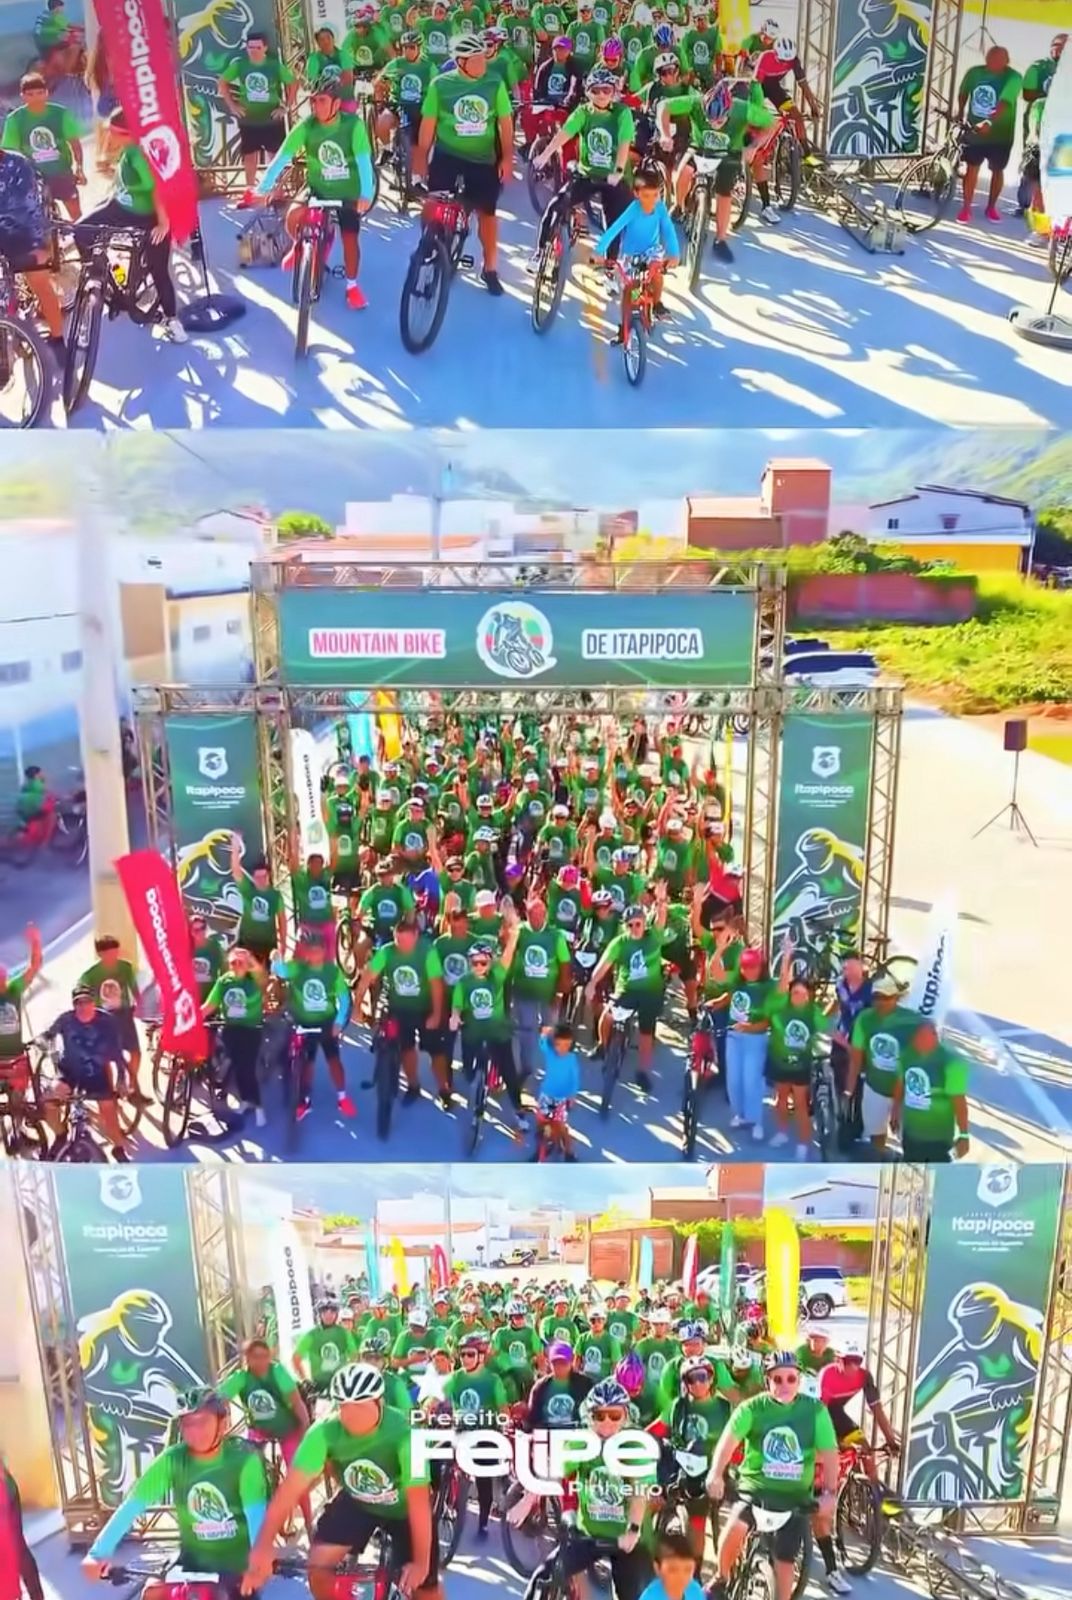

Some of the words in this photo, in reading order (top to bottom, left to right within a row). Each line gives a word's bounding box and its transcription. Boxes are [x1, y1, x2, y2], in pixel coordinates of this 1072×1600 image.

[313, 632, 399, 655] MOUNTAIN
[403, 632, 442, 655] BIKE
[586, 632, 607, 655] DE
[612, 632, 700, 655] ITAPIPOCA
[82, 1223, 169, 1241] Itapipoca
[952, 1216, 1036, 1235] Itapipoca
